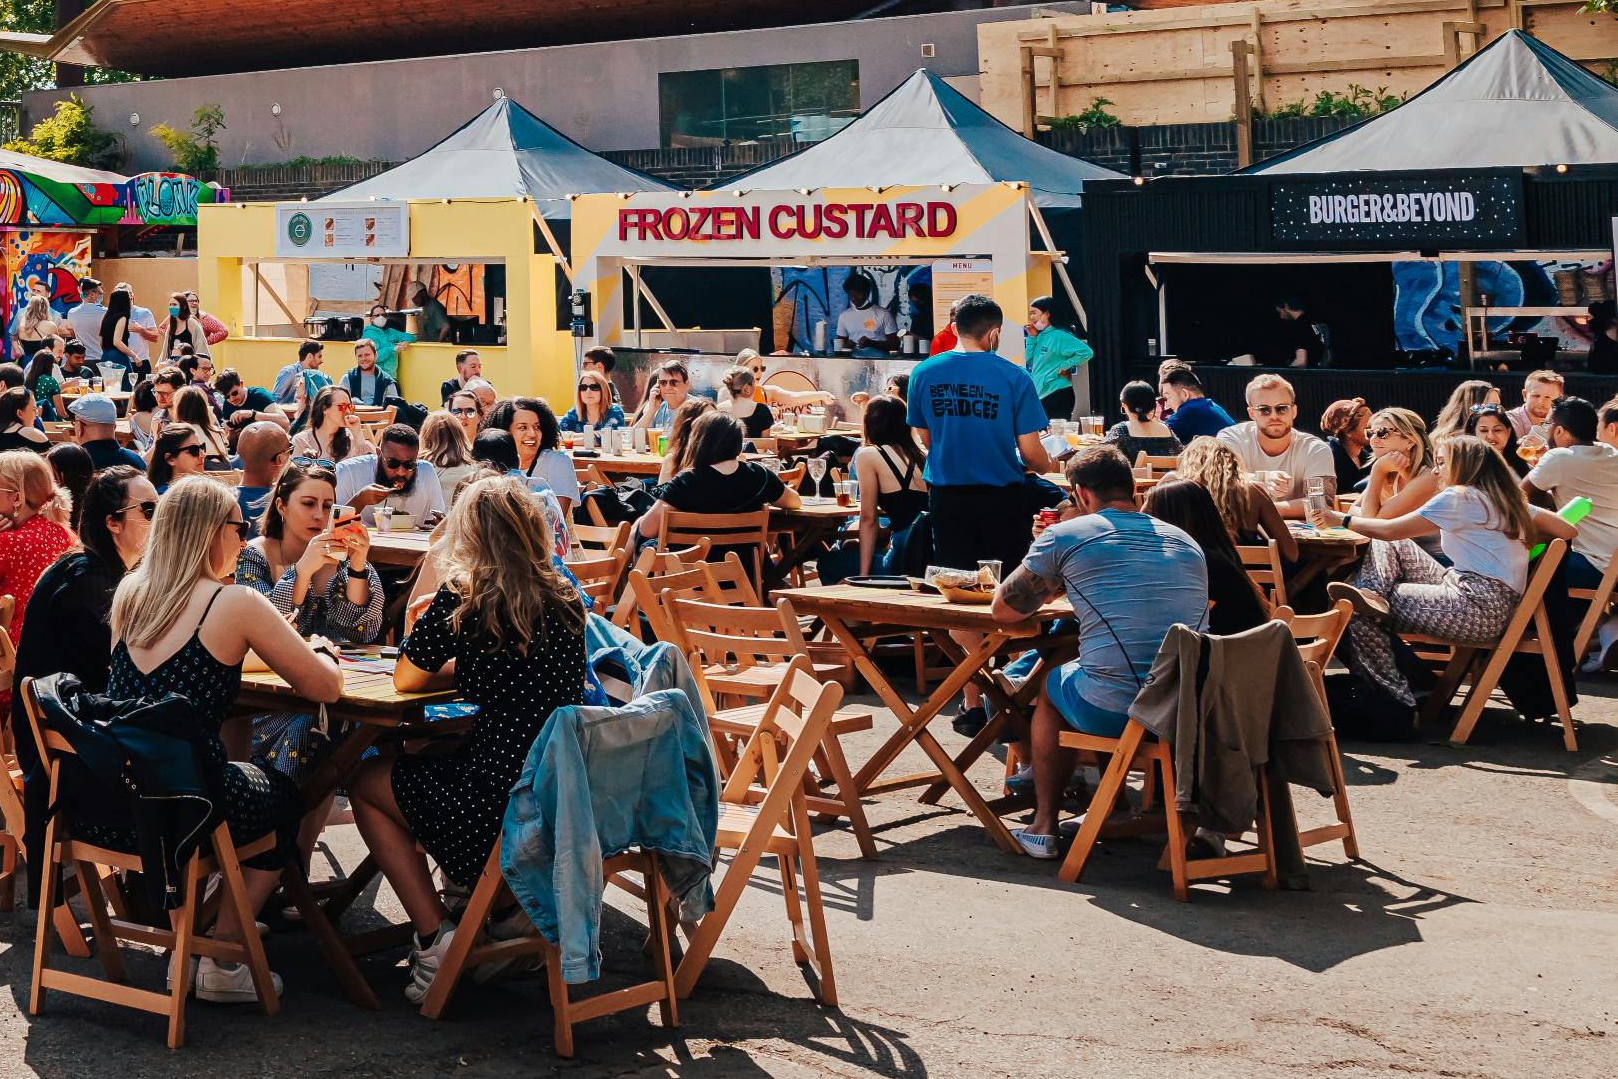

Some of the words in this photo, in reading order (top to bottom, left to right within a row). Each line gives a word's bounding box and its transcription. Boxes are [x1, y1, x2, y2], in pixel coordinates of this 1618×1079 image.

[136, 176, 199, 222] PLONK
[1308, 191, 1475, 224] BURGER&BEYOND
[617, 206, 761, 241] FROZEN
[767, 201, 959, 240] CUSTARD
[929, 384, 984, 398] BETWEEN
